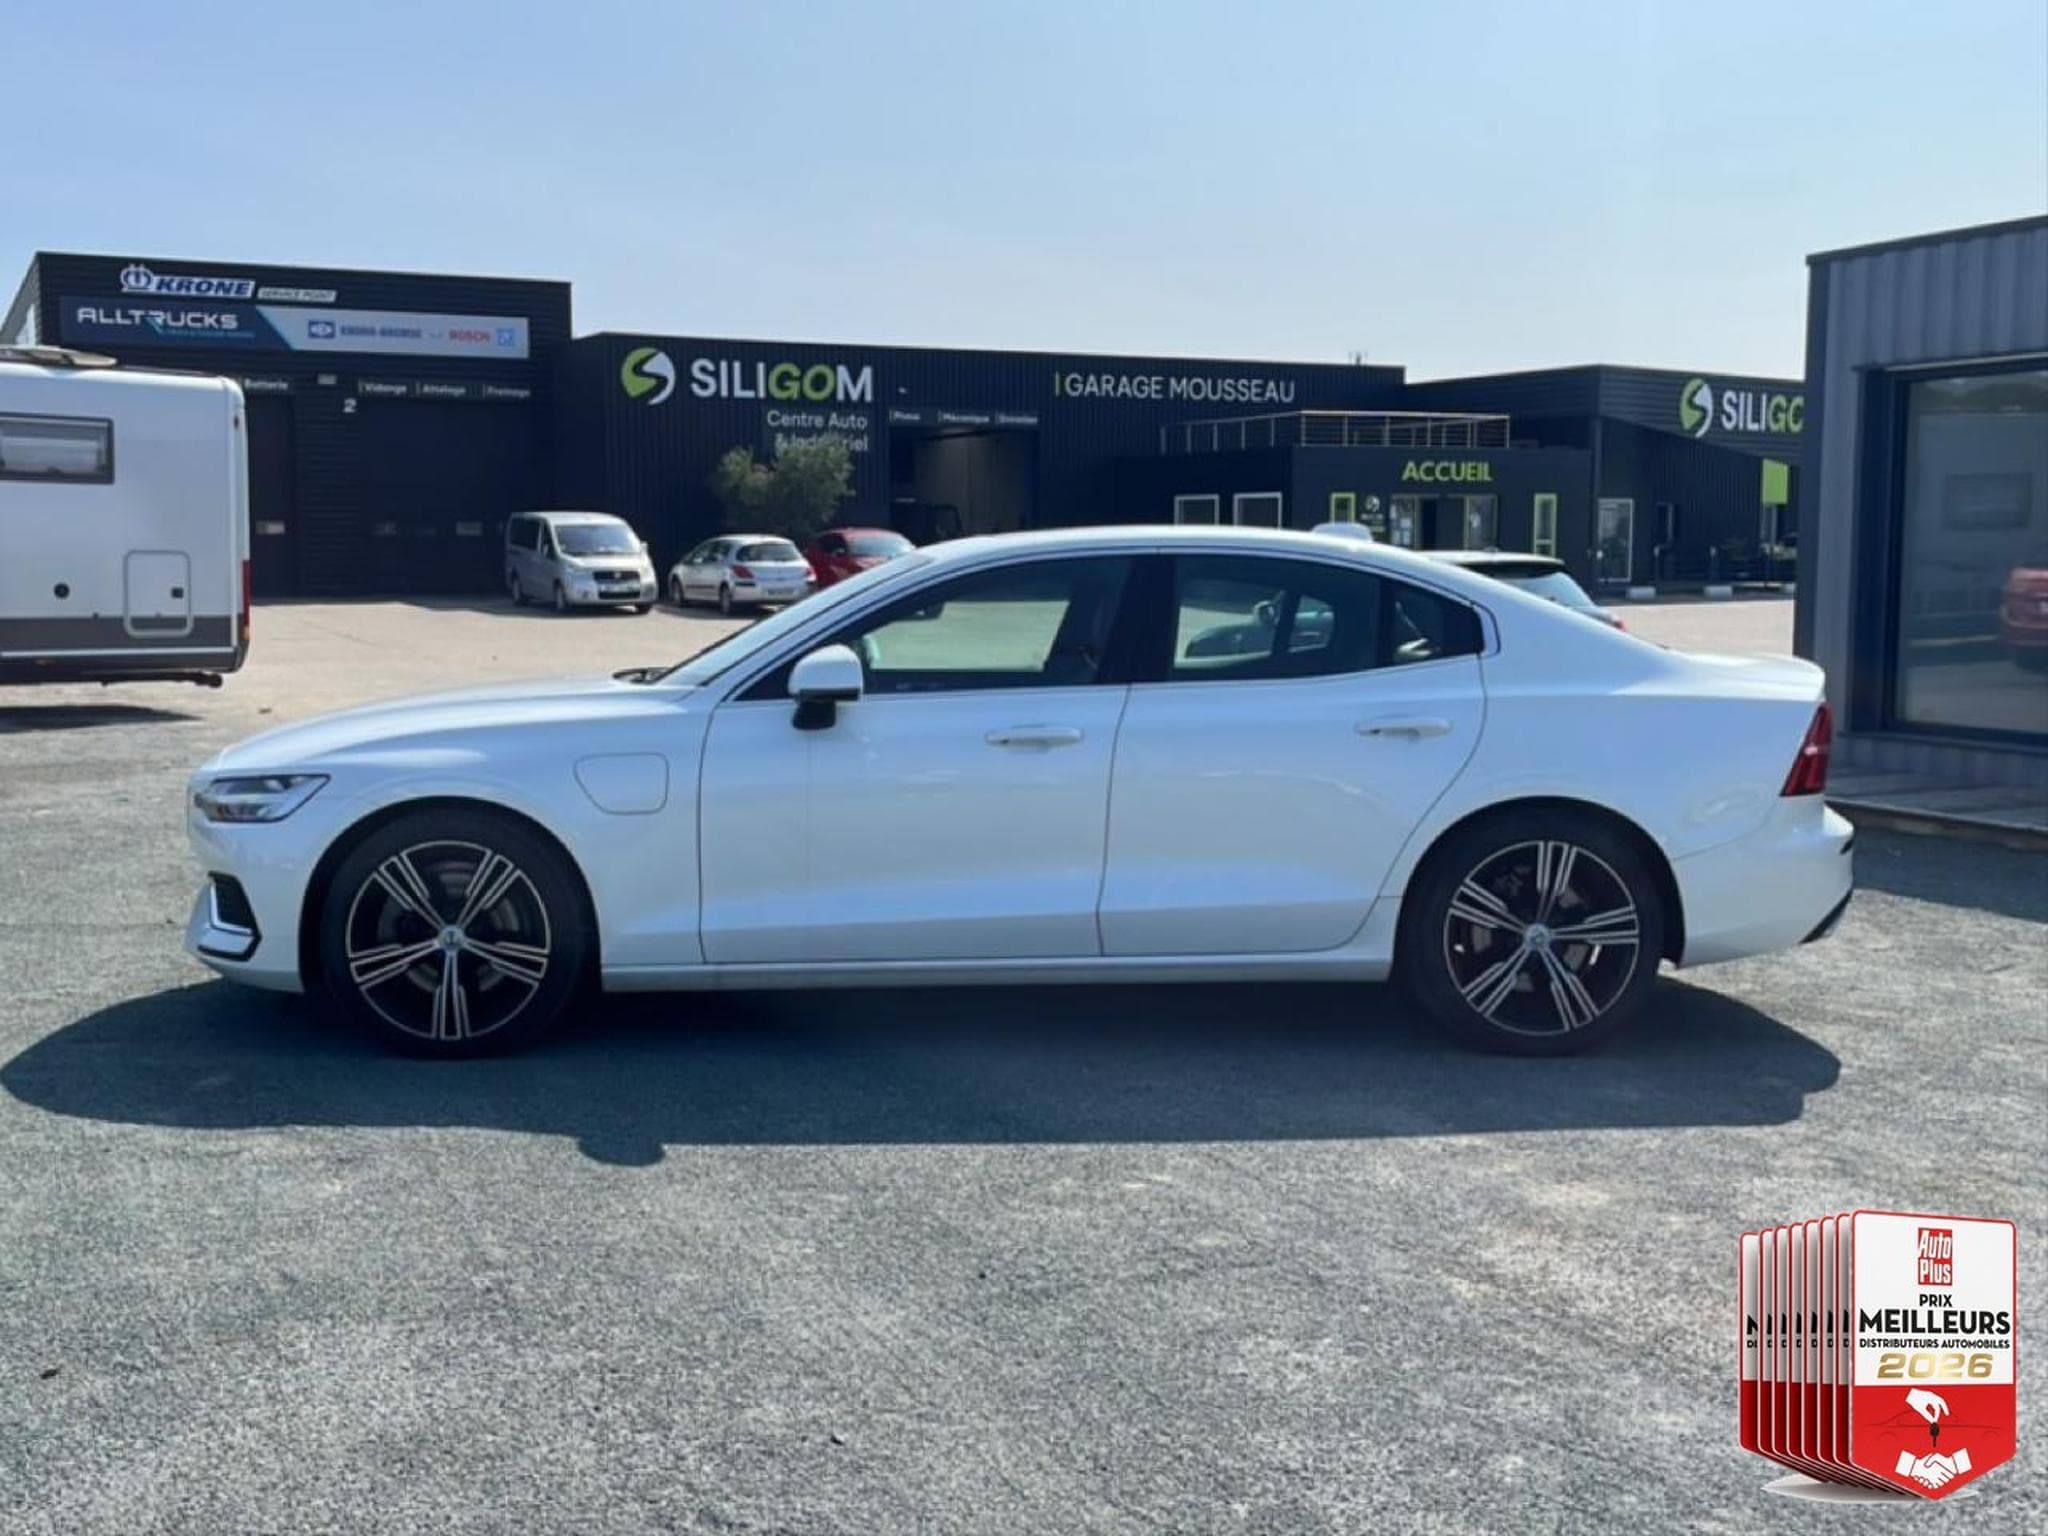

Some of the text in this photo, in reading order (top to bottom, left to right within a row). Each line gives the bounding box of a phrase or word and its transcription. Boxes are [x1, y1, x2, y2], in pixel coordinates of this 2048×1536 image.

[156, 277, 251, 297] KRONE
[76, 306, 239, 330] ALLTRUCKS
[690, 358, 873, 402] SILIGOM
[1064, 373, 1296, 402] GARAGE MOUSSEAU
[343, 399, 357, 413] 2
[766, 410, 869, 430] Centre Auto
[1402, 461, 1493, 482] ACCUEIL
